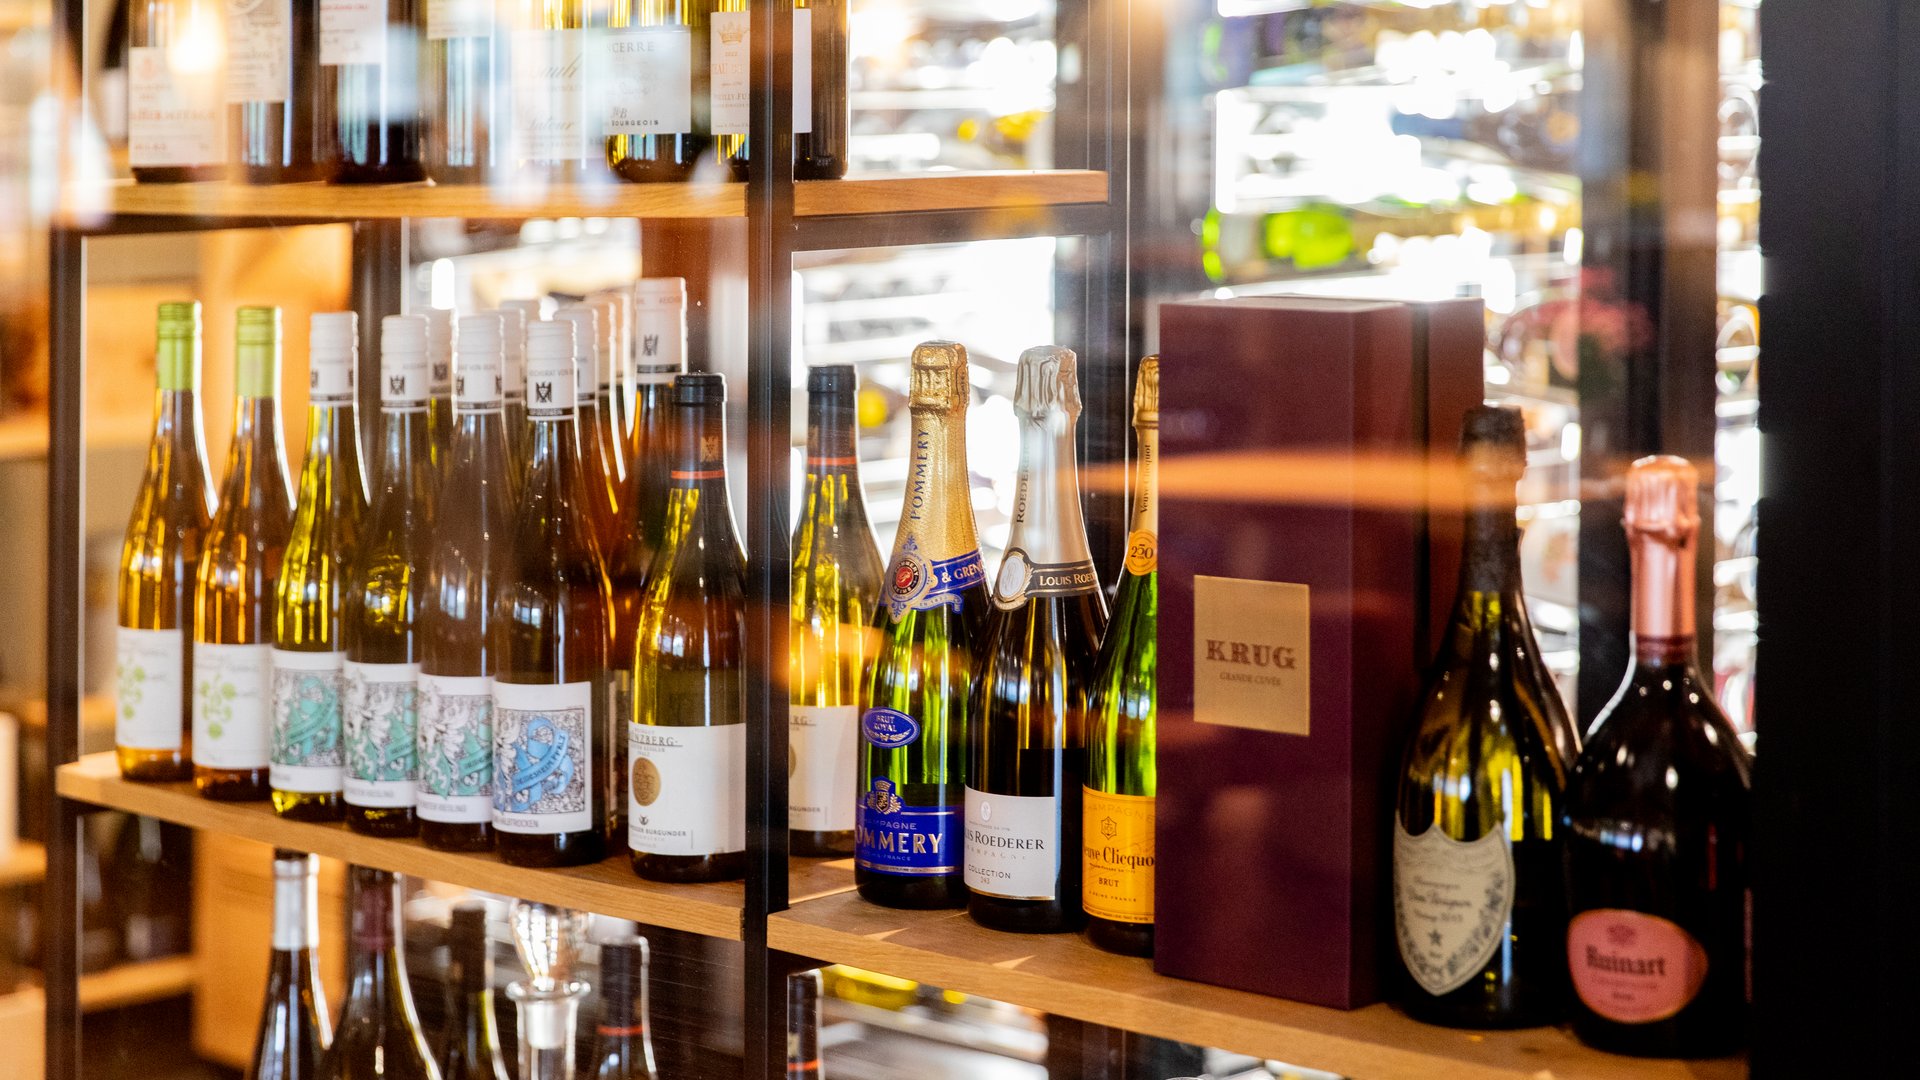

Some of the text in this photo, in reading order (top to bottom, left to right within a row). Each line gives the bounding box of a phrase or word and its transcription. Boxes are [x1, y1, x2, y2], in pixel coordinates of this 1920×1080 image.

[910, 429, 930, 521] POMMERY
[1131, 543, 1154, 560] 250
[941, 571, 953, 584] &
[1039, 575, 1073, 587] LOUIS
[1206, 639, 1297, 670] KRUG
[1220, 672, 1254, 684] GRANDE
[876, 714, 896, 725] BRUT
[645, 828, 688, 837] BURGUNDER
[855, 824, 943, 854] OMMERY
[975, 830, 1046, 850] ROEDERER
[1102, 845, 1154, 870] Clicquo
[968, 864, 1011, 879] COLLECTION
[1098, 876, 1120, 888] BRUT
[1586, 943, 1666, 977] Ruinart
